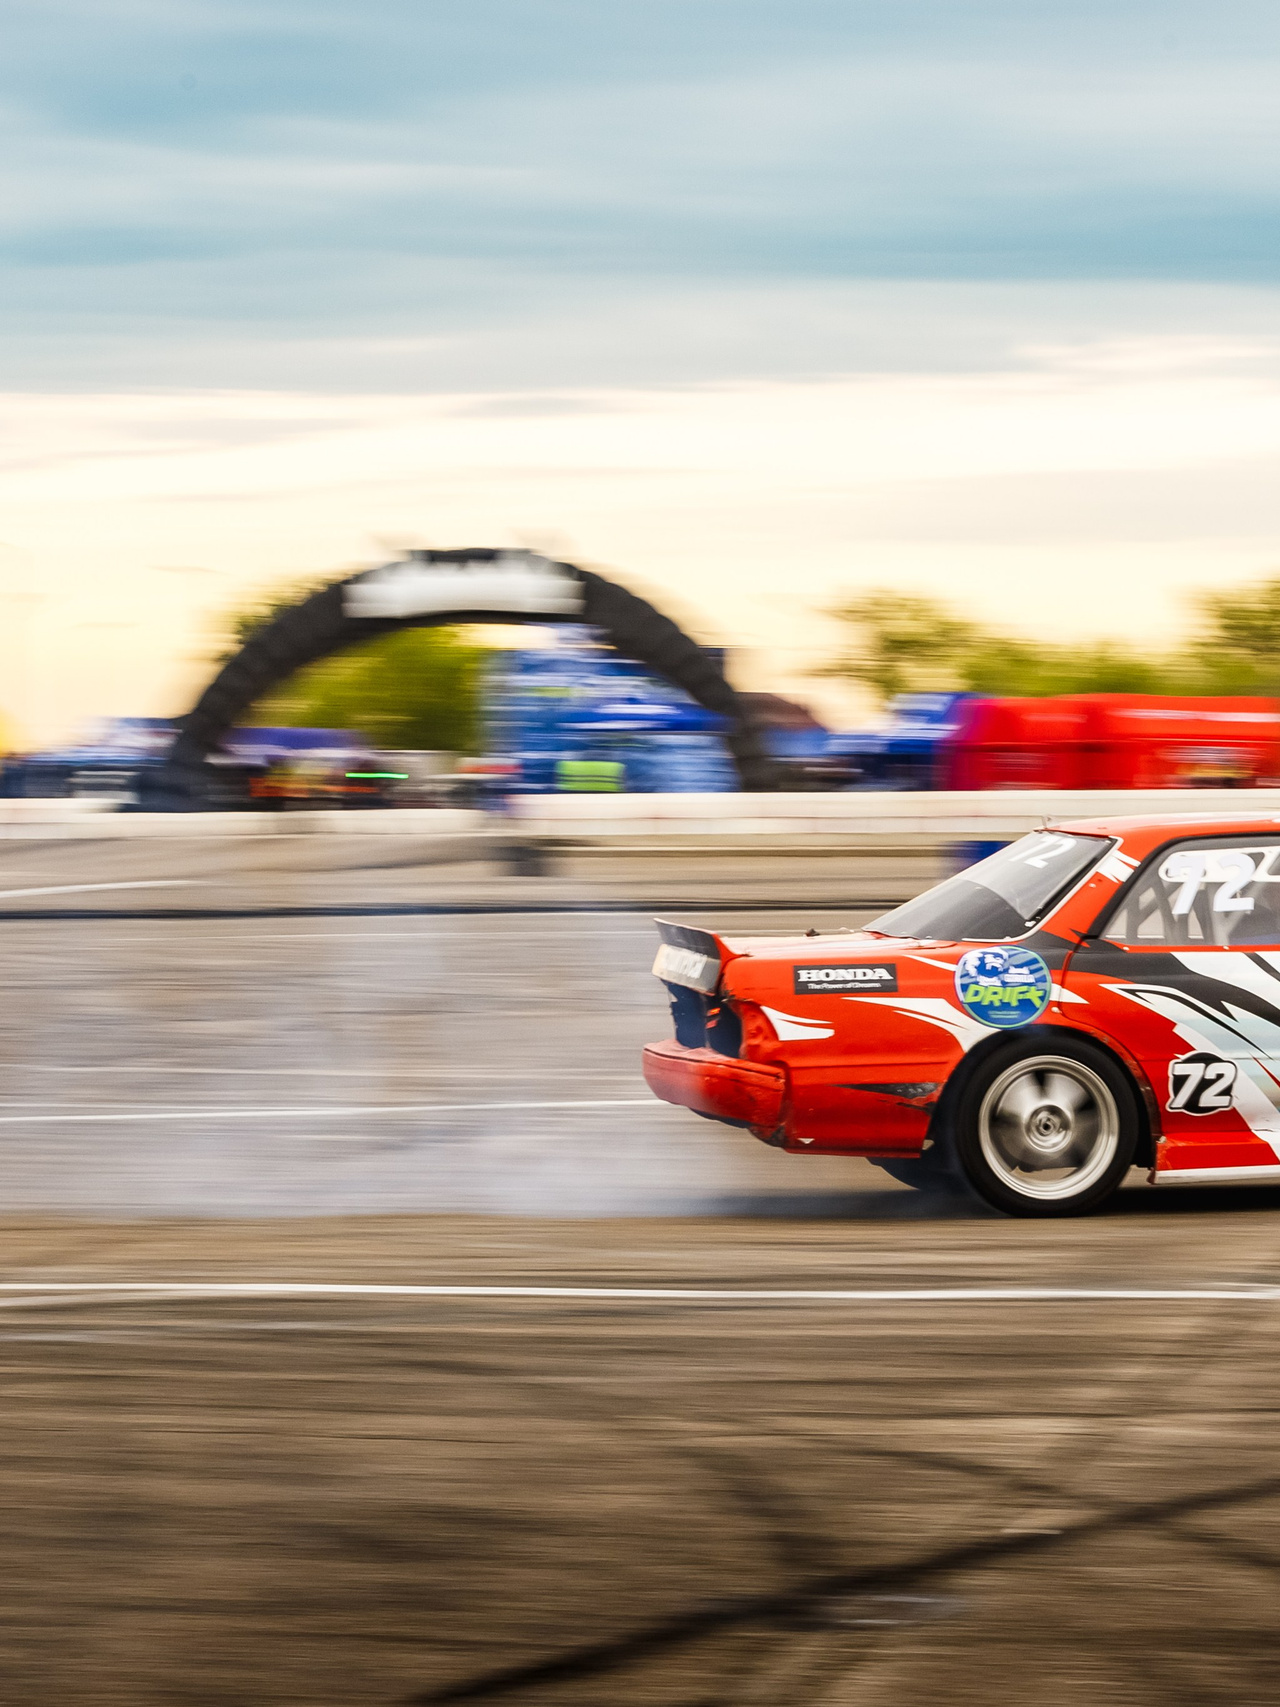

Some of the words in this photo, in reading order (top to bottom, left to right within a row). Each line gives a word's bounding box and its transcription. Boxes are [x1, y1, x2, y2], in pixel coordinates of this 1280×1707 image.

[1008, 835, 1077, 869] 72
[1167, 853, 1256, 915] 72
[797, 968, 894, 982] HONDA
[964, 984, 1045, 1008] DRIFT
[1170, 1062, 1236, 1108] 72
